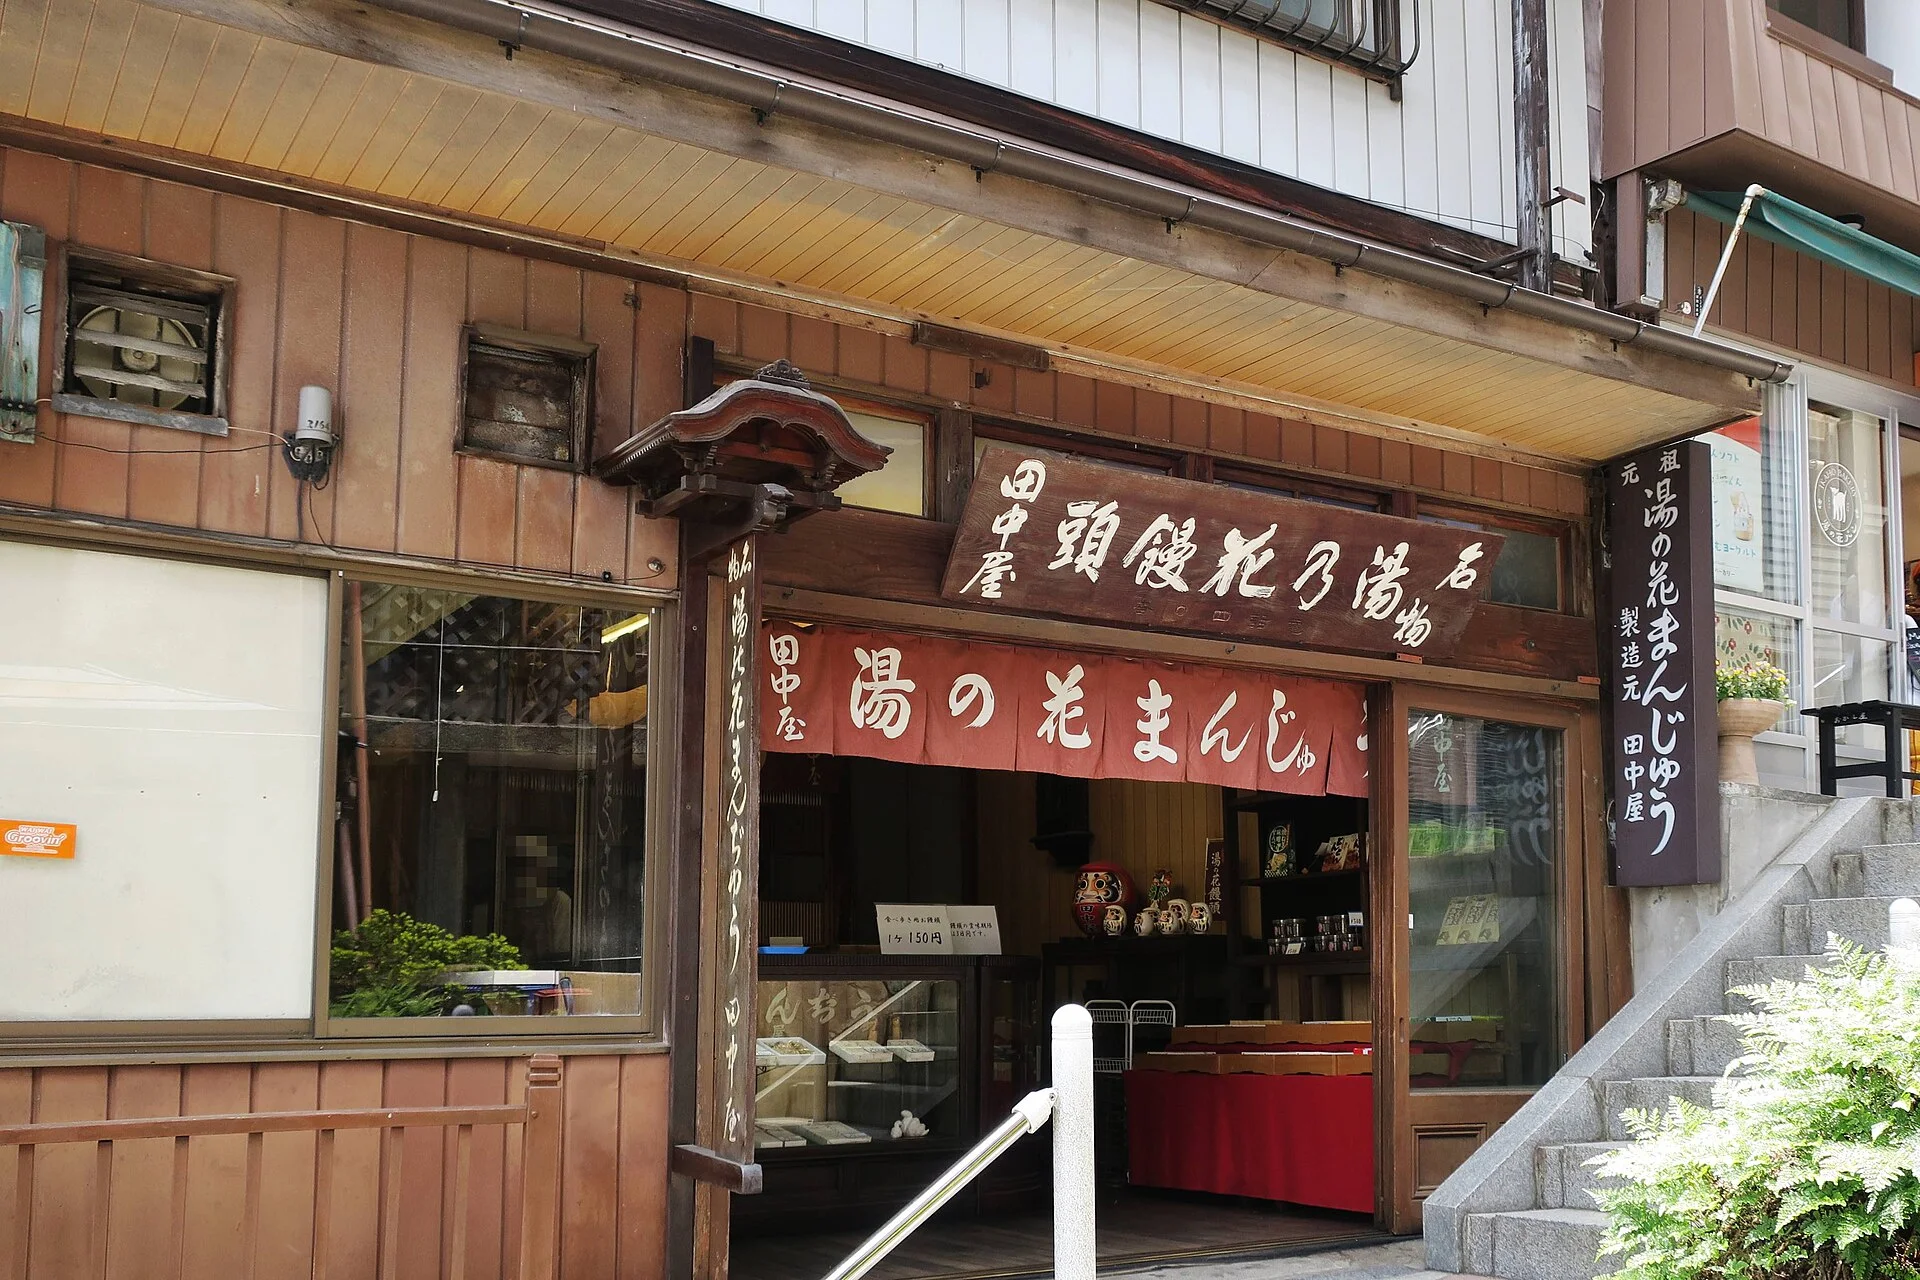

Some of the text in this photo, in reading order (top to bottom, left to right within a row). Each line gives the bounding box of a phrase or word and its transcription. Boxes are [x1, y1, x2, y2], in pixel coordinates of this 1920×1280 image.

[960, 459, 1046, 599] 田中屋
[769, 634, 806, 741] 田中屋
[849, 647, 1368, 778] 湯の花まんじゅ
[1619, 606, 1645, 822] 製造元 田中屋
[909, 931, 942, 945] 150円
[1206, 851, 1222, 915] 湯の花饅頭
